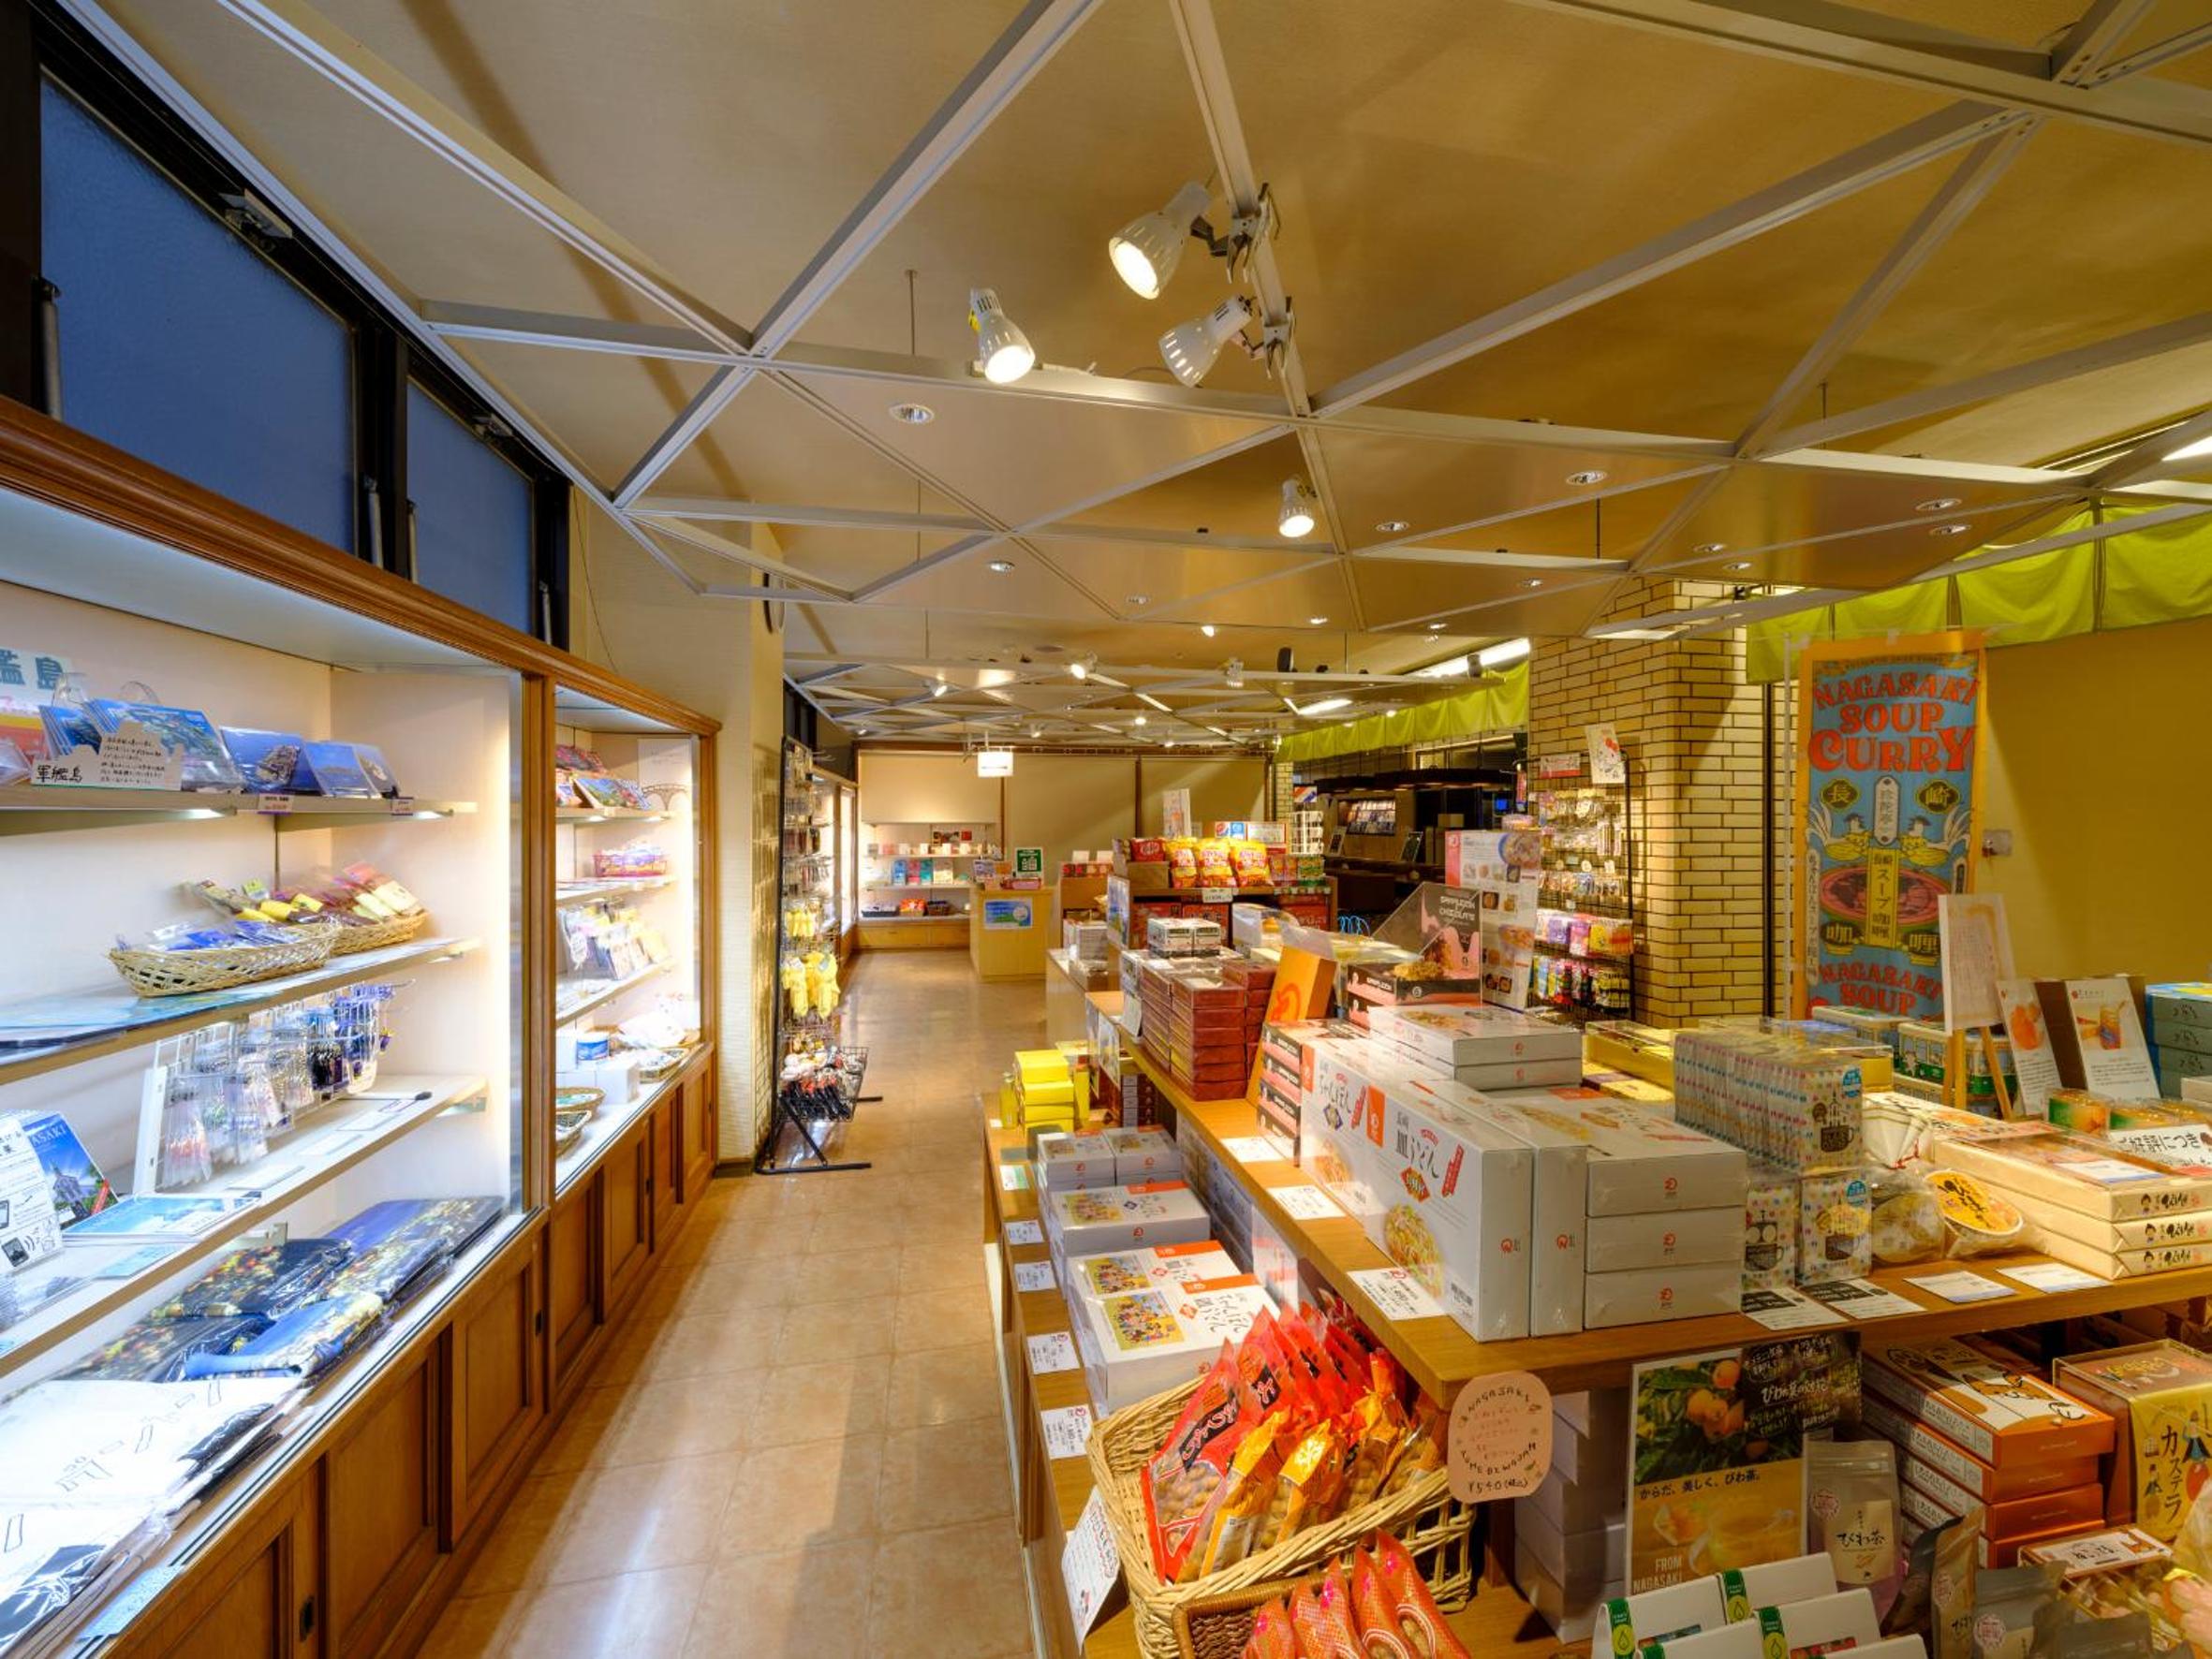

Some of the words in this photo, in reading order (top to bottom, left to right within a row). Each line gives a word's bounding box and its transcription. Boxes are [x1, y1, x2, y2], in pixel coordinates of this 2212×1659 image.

[1813, 670, 1980, 708] NAGASAKI
[1838, 702, 1944, 734] SOUP
[1808, 725, 1976, 772] CURRY
[37, 764, 83, 784] 軍艦島
[1830, 786, 1851, 805] 長
[1925, 786, 1950, 806] 崎
[1840, 983, 1917, 1016] SOUP
[31, 1123, 66, 1148] ASAKI
[1467, 1387, 1529, 1413] NAGASAKI
[2160, 1425, 2185, 1523] カステラ
[1655, 1556, 1683, 1573] FROM
[1632, 1572, 1683, 1593] NAGASAKI
